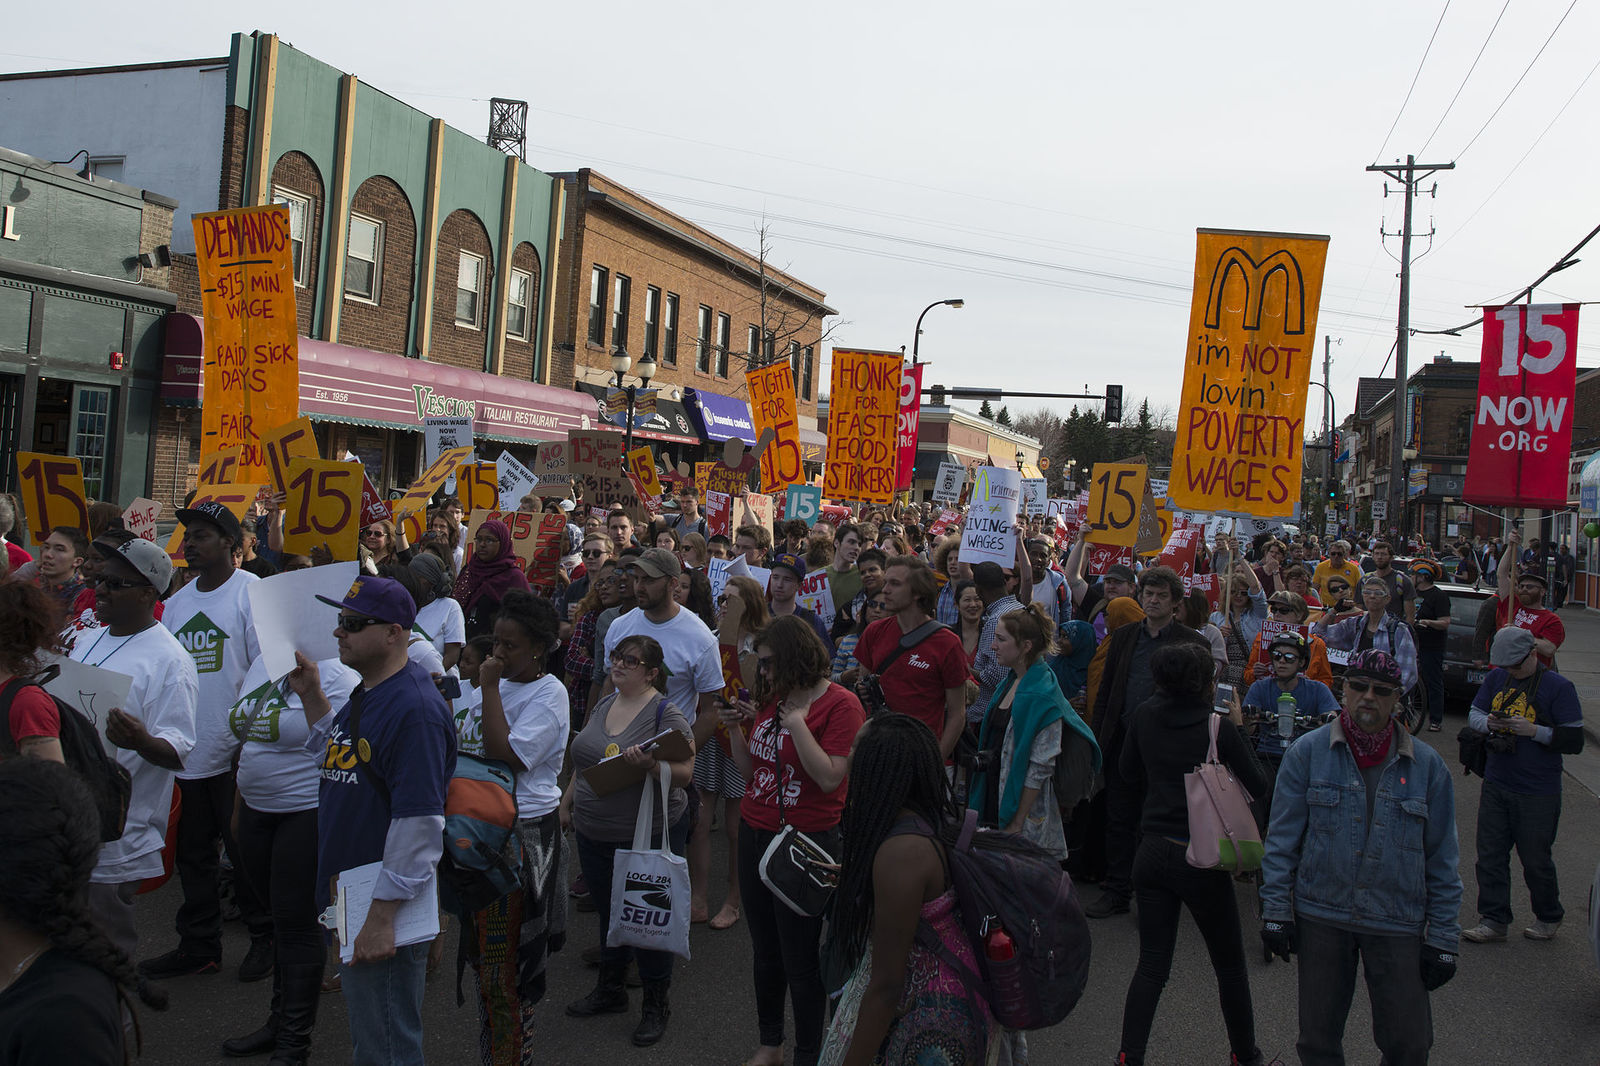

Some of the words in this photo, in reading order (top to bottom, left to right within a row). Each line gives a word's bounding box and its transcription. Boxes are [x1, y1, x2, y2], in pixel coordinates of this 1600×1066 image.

[227, 299, 275, 319] WAGE
[1495, 304, 1568, 378] 15
[840, 359, 899, 392] HONK
[1240, 347, 1301, 382] NOT
[222, 367, 266, 392] DAYS
[751, 366, 791, 399] FIGHT
[332, 392, 348, 402] 1956
[762, 398, 790, 421] FOR
[855, 396, 879, 410] FOR
[427, 419, 448, 427] LIVING
[484, 407, 511, 422] ITALIAN
[515, 410, 558, 428] RESTAURANT
[837, 412, 893, 439] FAST
[1477, 395, 1568, 433] NOW
[1187, 407, 1303, 460] POVERTY
[1489, 430, 1548, 454] .ORG
[836, 438, 888, 464] FOOD
[502, 454, 520, 471] LIVING
[519, 468, 536, 484] WAGE
[631, 455, 653, 485] 15
[1185, 458, 1290, 505] WAGES
[289, 468, 352, 534] 15
[461, 466, 498, 515] 15
[1090, 470, 1135, 530] 15
[791, 491, 815, 519] 15
[487, 511, 533, 540] 15
[967, 535, 1005, 550] WAGES
[1117, 556, 1132, 568] 15
[798, 573, 829, 597] NOT
[1262, 620, 1285, 633] RAISE
[1286, 623, 1301, 633] THE
[178, 629, 217, 652] NOC
[235, 698, 279, 719] NC
[626, 872, 654, 883] LOCAL
[620, 907, 672, 927] SEIU
[643, 927, 672, 938] Together
